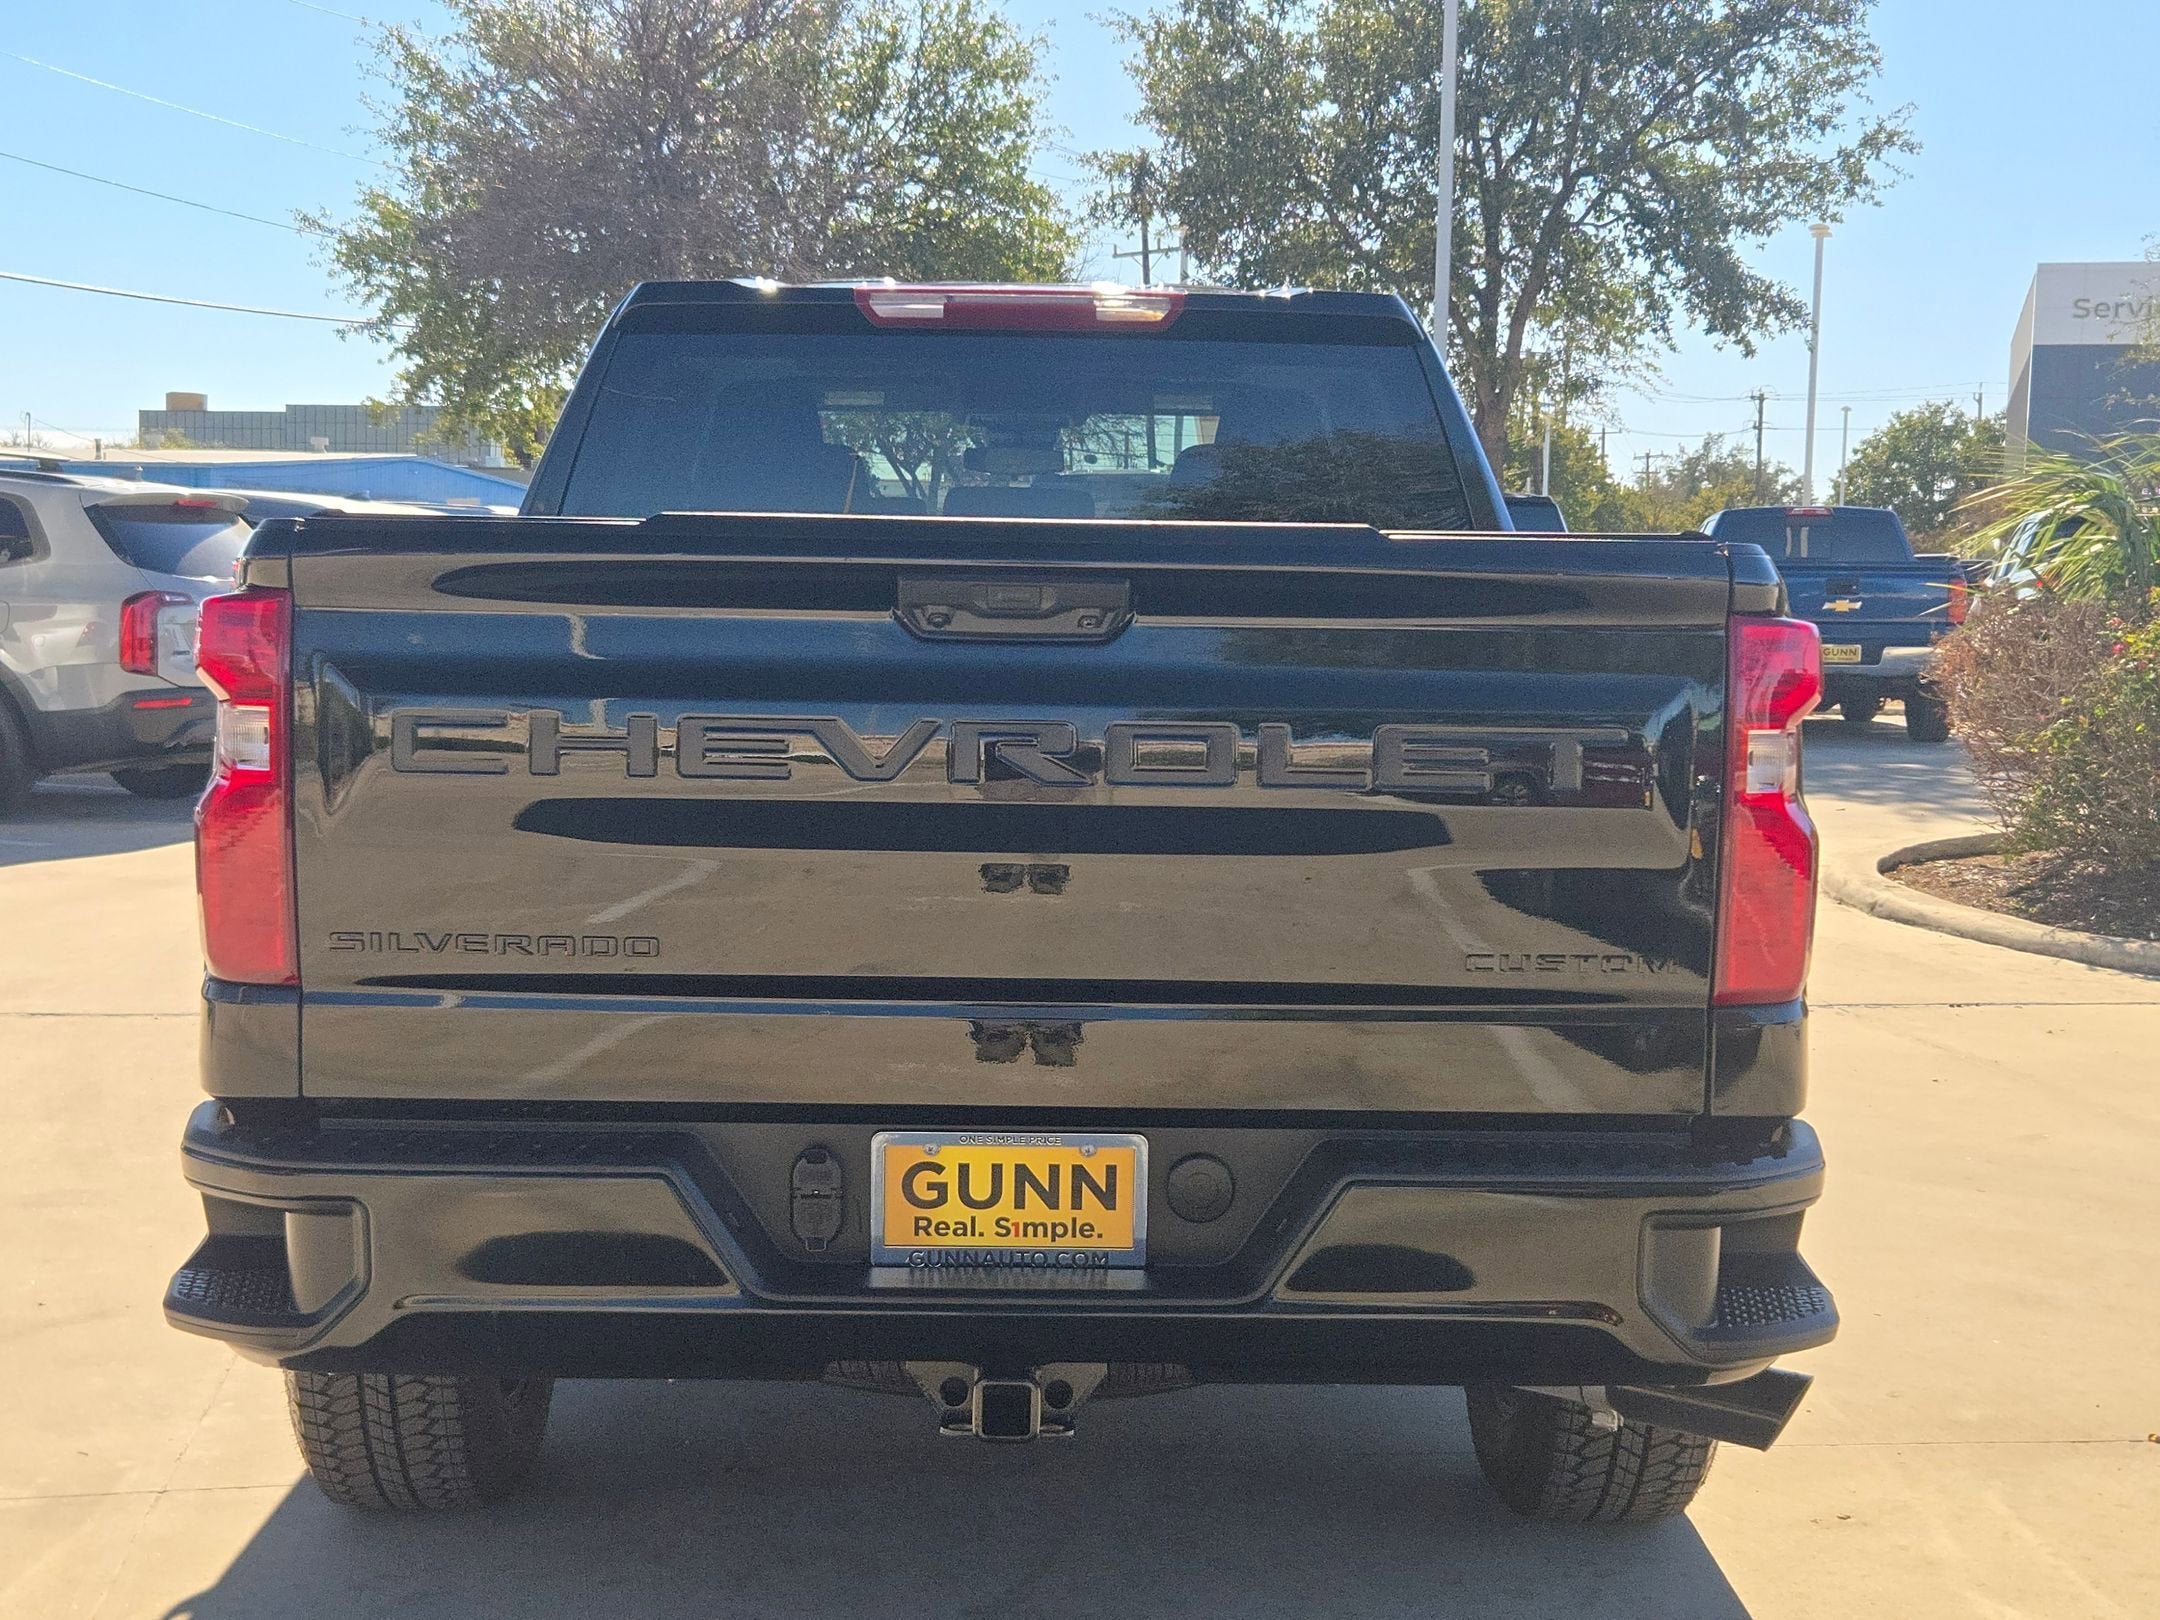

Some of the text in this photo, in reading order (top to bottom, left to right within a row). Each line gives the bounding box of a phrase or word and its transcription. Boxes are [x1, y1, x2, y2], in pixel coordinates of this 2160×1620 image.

[1823, 648, 1857, 656] GUNN
[392, 707, 1630, 793] CHEVROLET
[328, 931, 660, 958] SILVERADO
[1465, 953, 1680, 974] CUSTOM
[959, 1135, 1062, 1146] ONE SIMPLE PRICE
[901, 1161, 1117, 1211] GUNN
[914, 1215, 985, 1237] Real.
